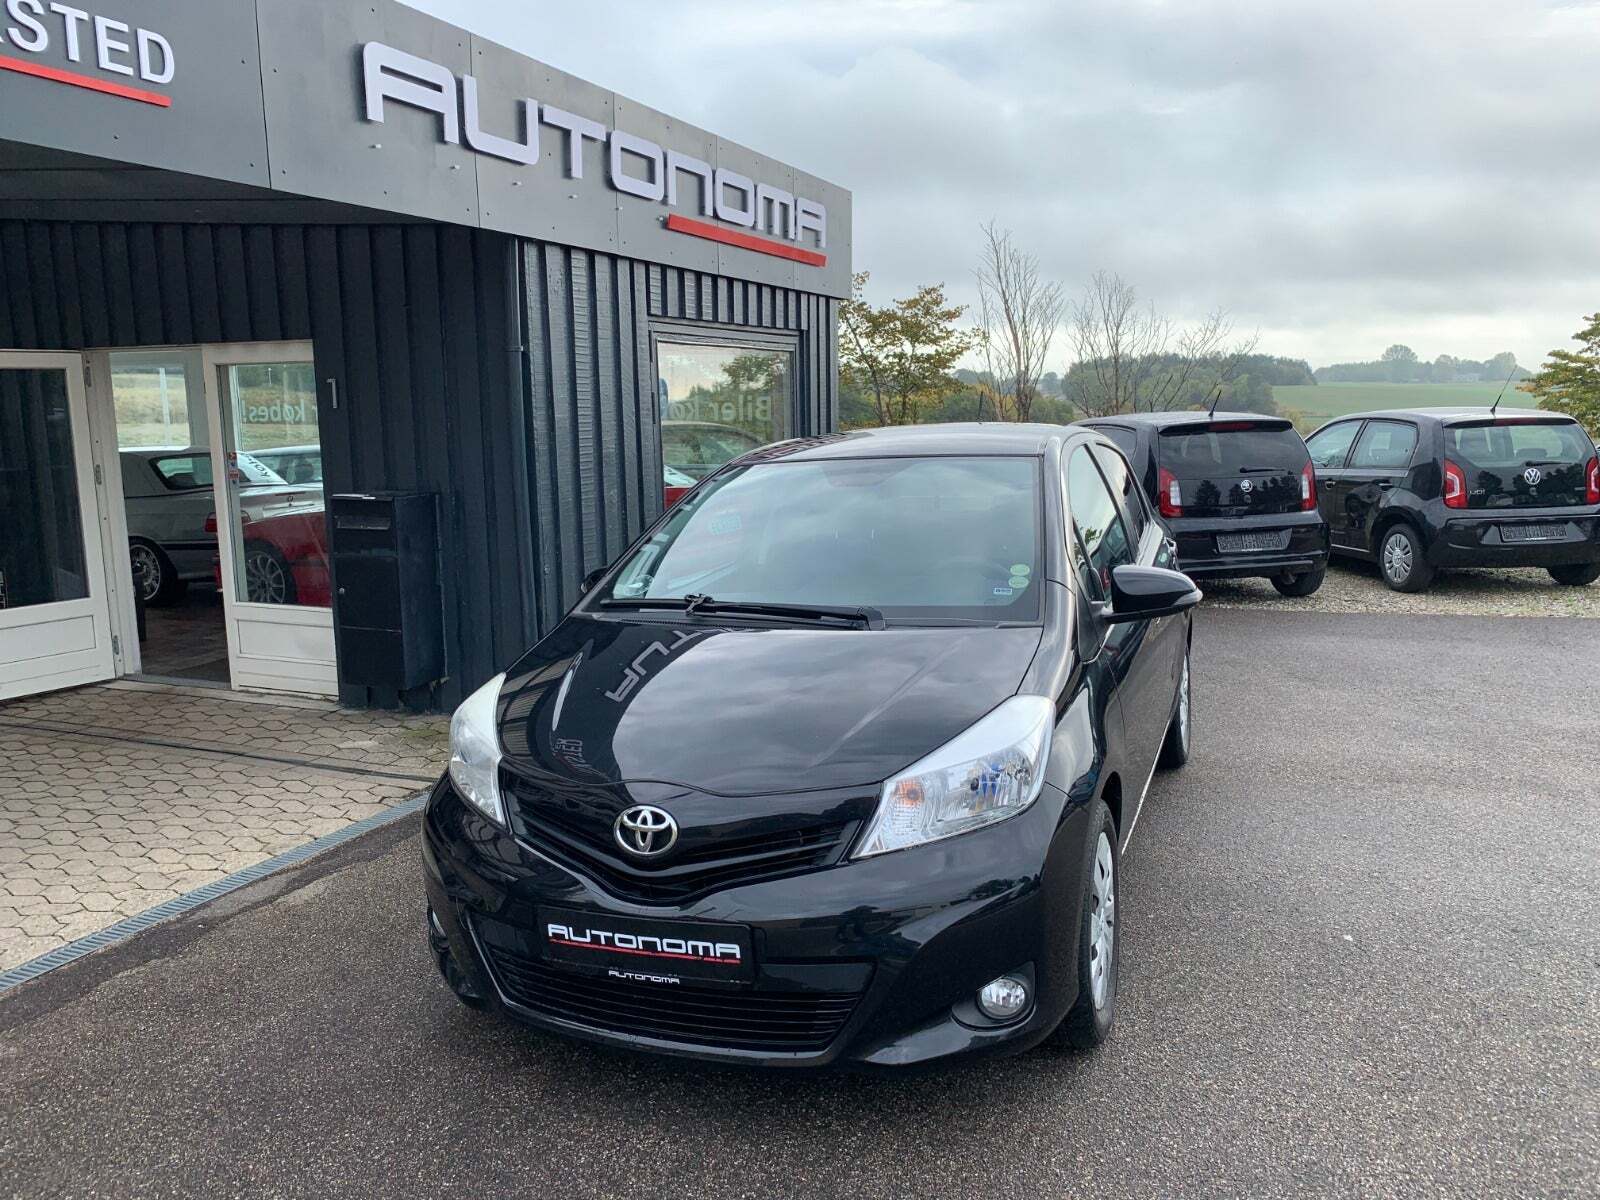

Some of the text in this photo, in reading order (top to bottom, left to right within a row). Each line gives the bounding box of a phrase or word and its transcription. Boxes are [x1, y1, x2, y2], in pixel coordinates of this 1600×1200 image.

[0, 0, 175, 84] STED
[363, 41, 827, 247] AUTONOMA
[547, 923, 741, 959] AUTONOMA
[608, 970, 680, 985] AUTONOMA
